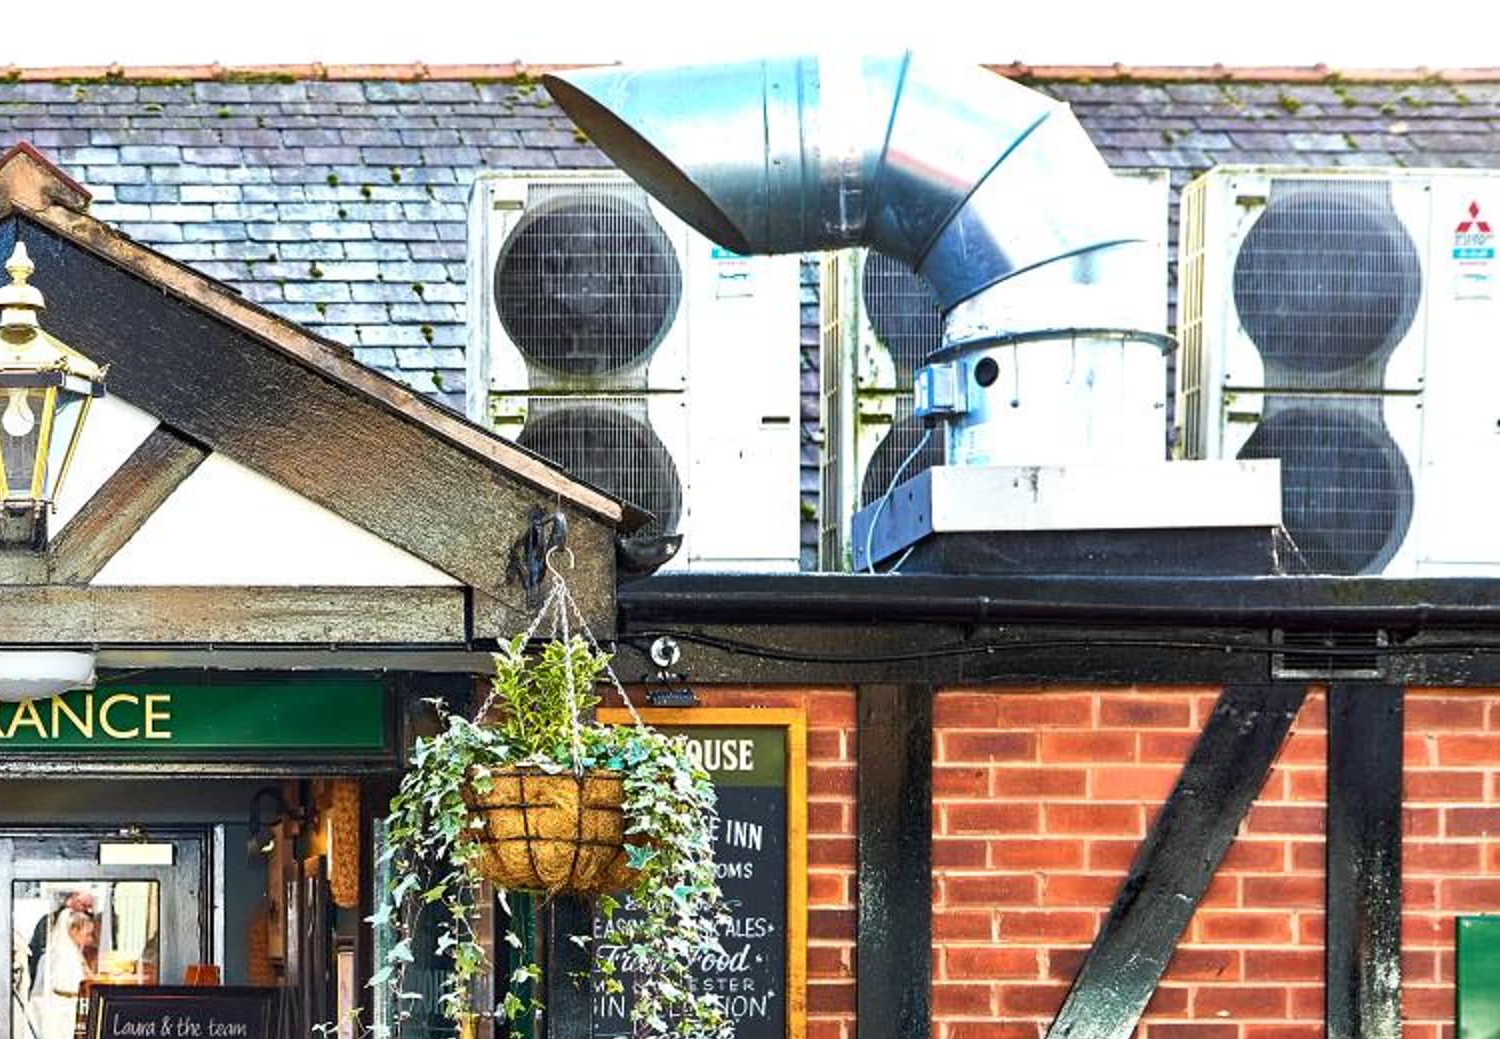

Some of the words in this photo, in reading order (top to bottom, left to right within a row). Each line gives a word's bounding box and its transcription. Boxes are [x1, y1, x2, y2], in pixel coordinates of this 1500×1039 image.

[726, 819, 763, 851] INN
[113, 1013, 156, 1037] Laura
[160, 1015, 172, 1037] &
[177, 1016, 202, 1037] the
[209, 1018, 249, 1037] team
